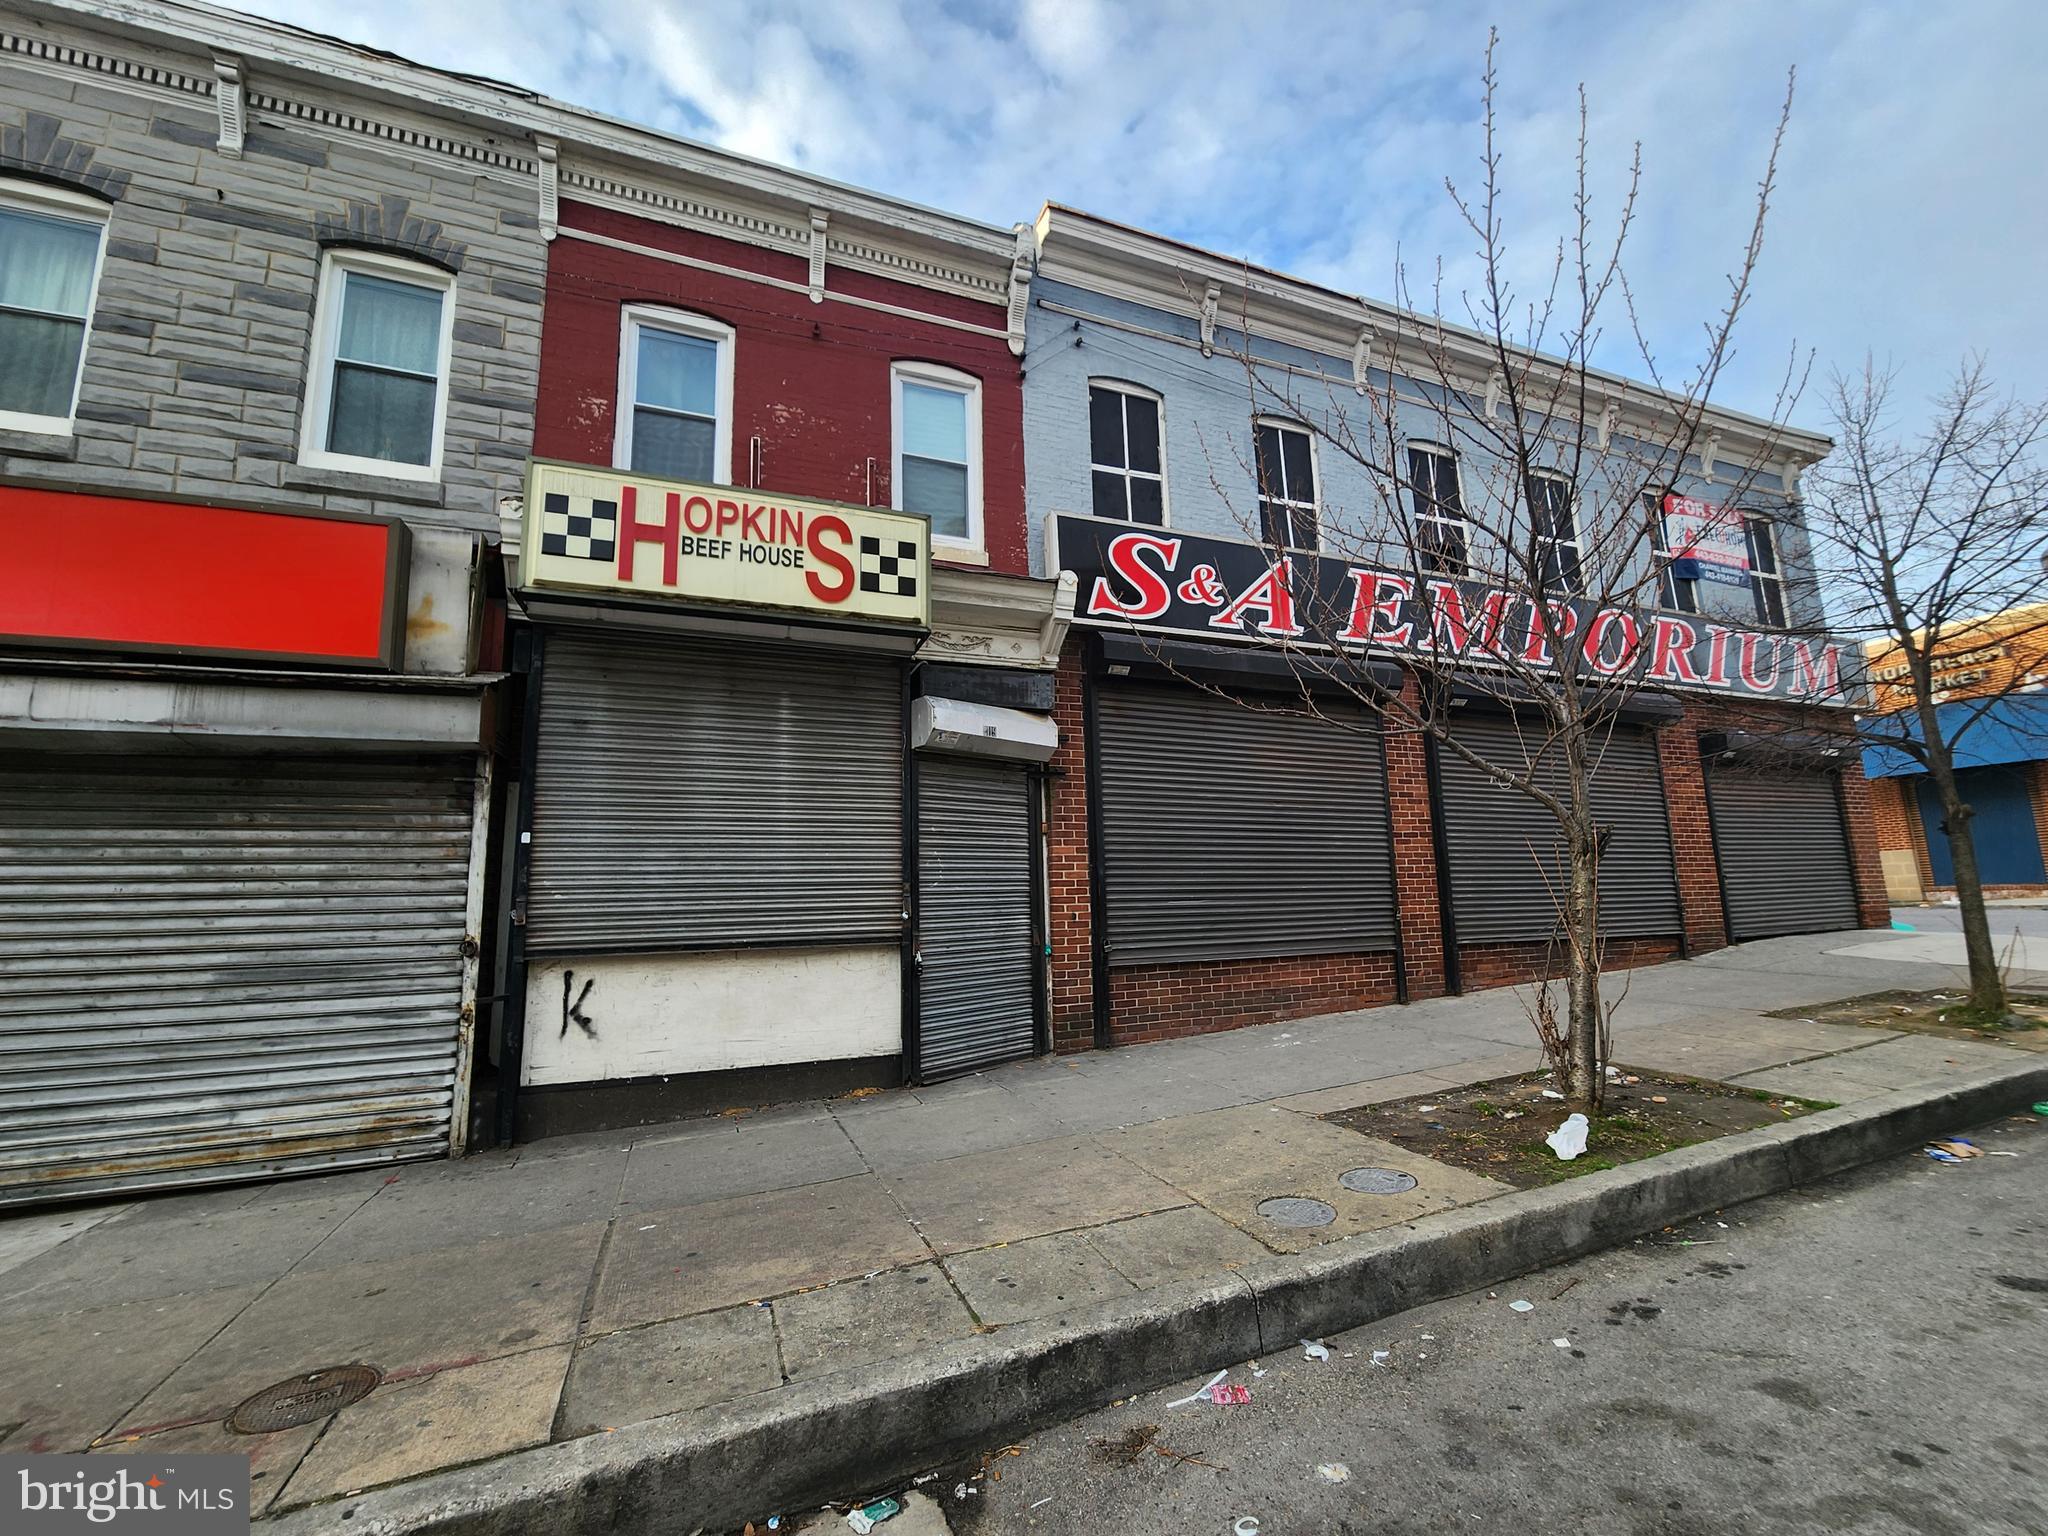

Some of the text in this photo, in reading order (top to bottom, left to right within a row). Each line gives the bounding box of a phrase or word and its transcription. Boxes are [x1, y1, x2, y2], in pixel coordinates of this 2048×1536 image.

[618, 486, 855, 604] HOPKINS
[681, 535, 804, 569] BEEF HOUSE
[1336, 567, 1848, 700] EMPORIUM
